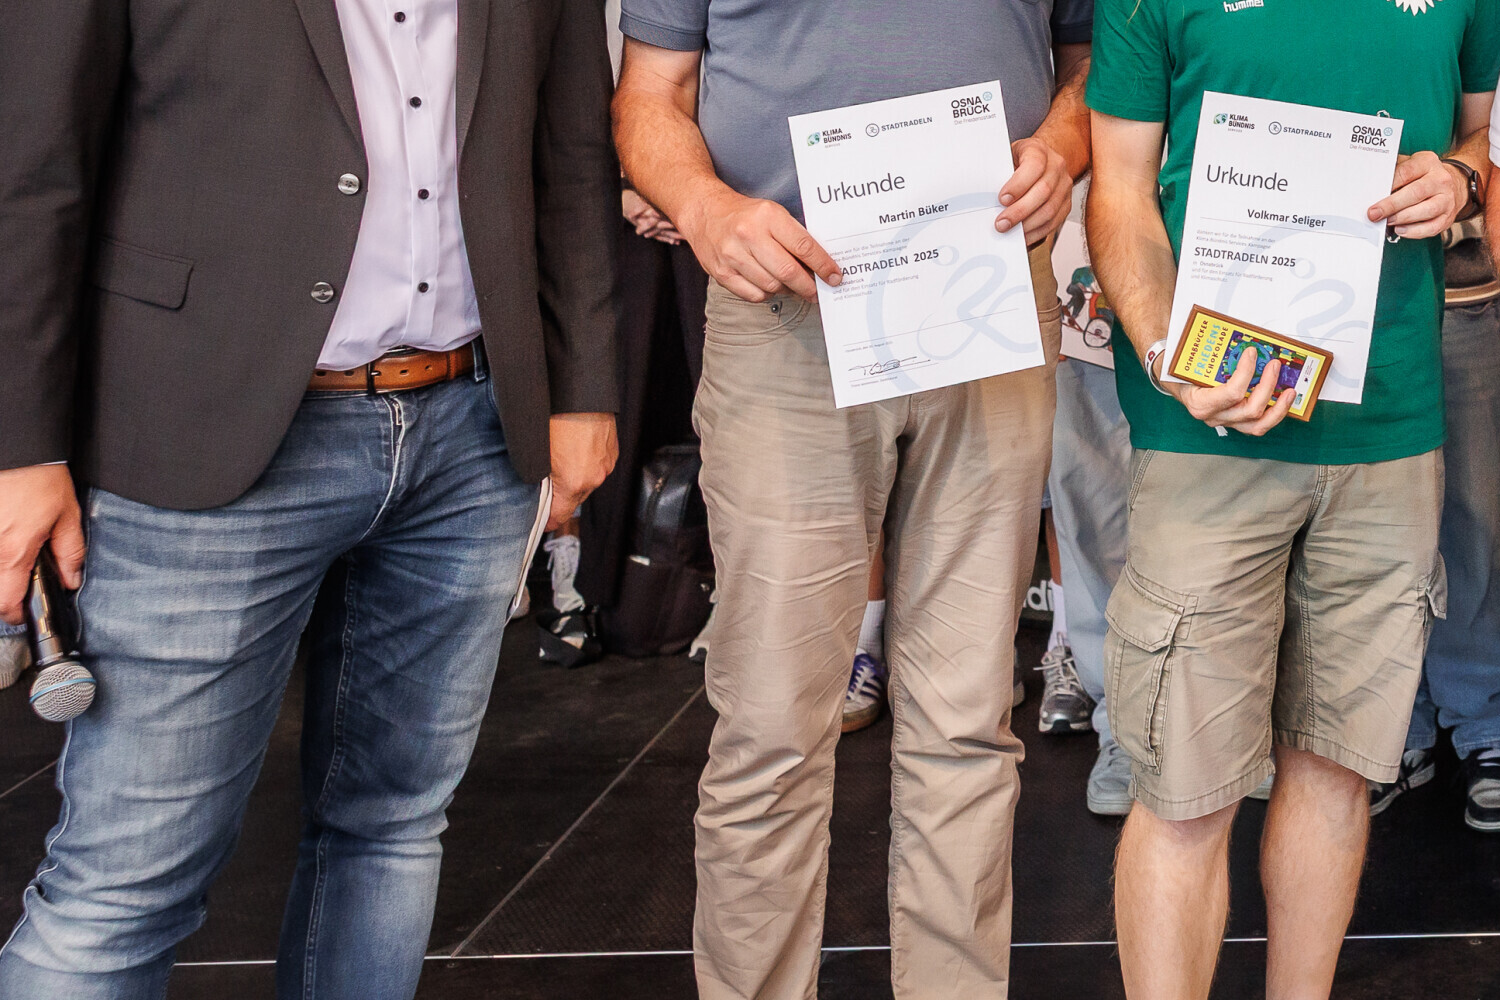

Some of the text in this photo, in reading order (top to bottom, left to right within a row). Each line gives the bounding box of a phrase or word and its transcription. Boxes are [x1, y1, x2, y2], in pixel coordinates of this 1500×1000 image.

[951, 96, 982, 108] OSNA
[953, 103, 989, 118] BRÜCK
[882, 117, 932, 131] STADTRADELN
[1229, 121, 1254, 129] BÜNDNIS
[1353, 126, 1381, 137] OSNA
[823, 128, 842, 136] KLIMA
[824, 133, 851, 143] BÜNDNIS
[1284, 127, 1331, 138] STADTRADELN
[1351, 134, 1386, 146] BRÜCK
[1207, 165, 1287, 191] Urkunde
[817, 173, 904, 203] Urkunde
[879, 204, 948, 224] Martin Büker
[1248, 209, 1326, 227] Volkmar Seliger
[839, 249, 938, 276] ADTRADELN 2025
[1195, 247, 1295, 267] STADTRADELN 2025
[1184, 319, 1209, 371] OSNABRÜCKER
[1204, 326, 1229, 378] SCHOKOLADE
